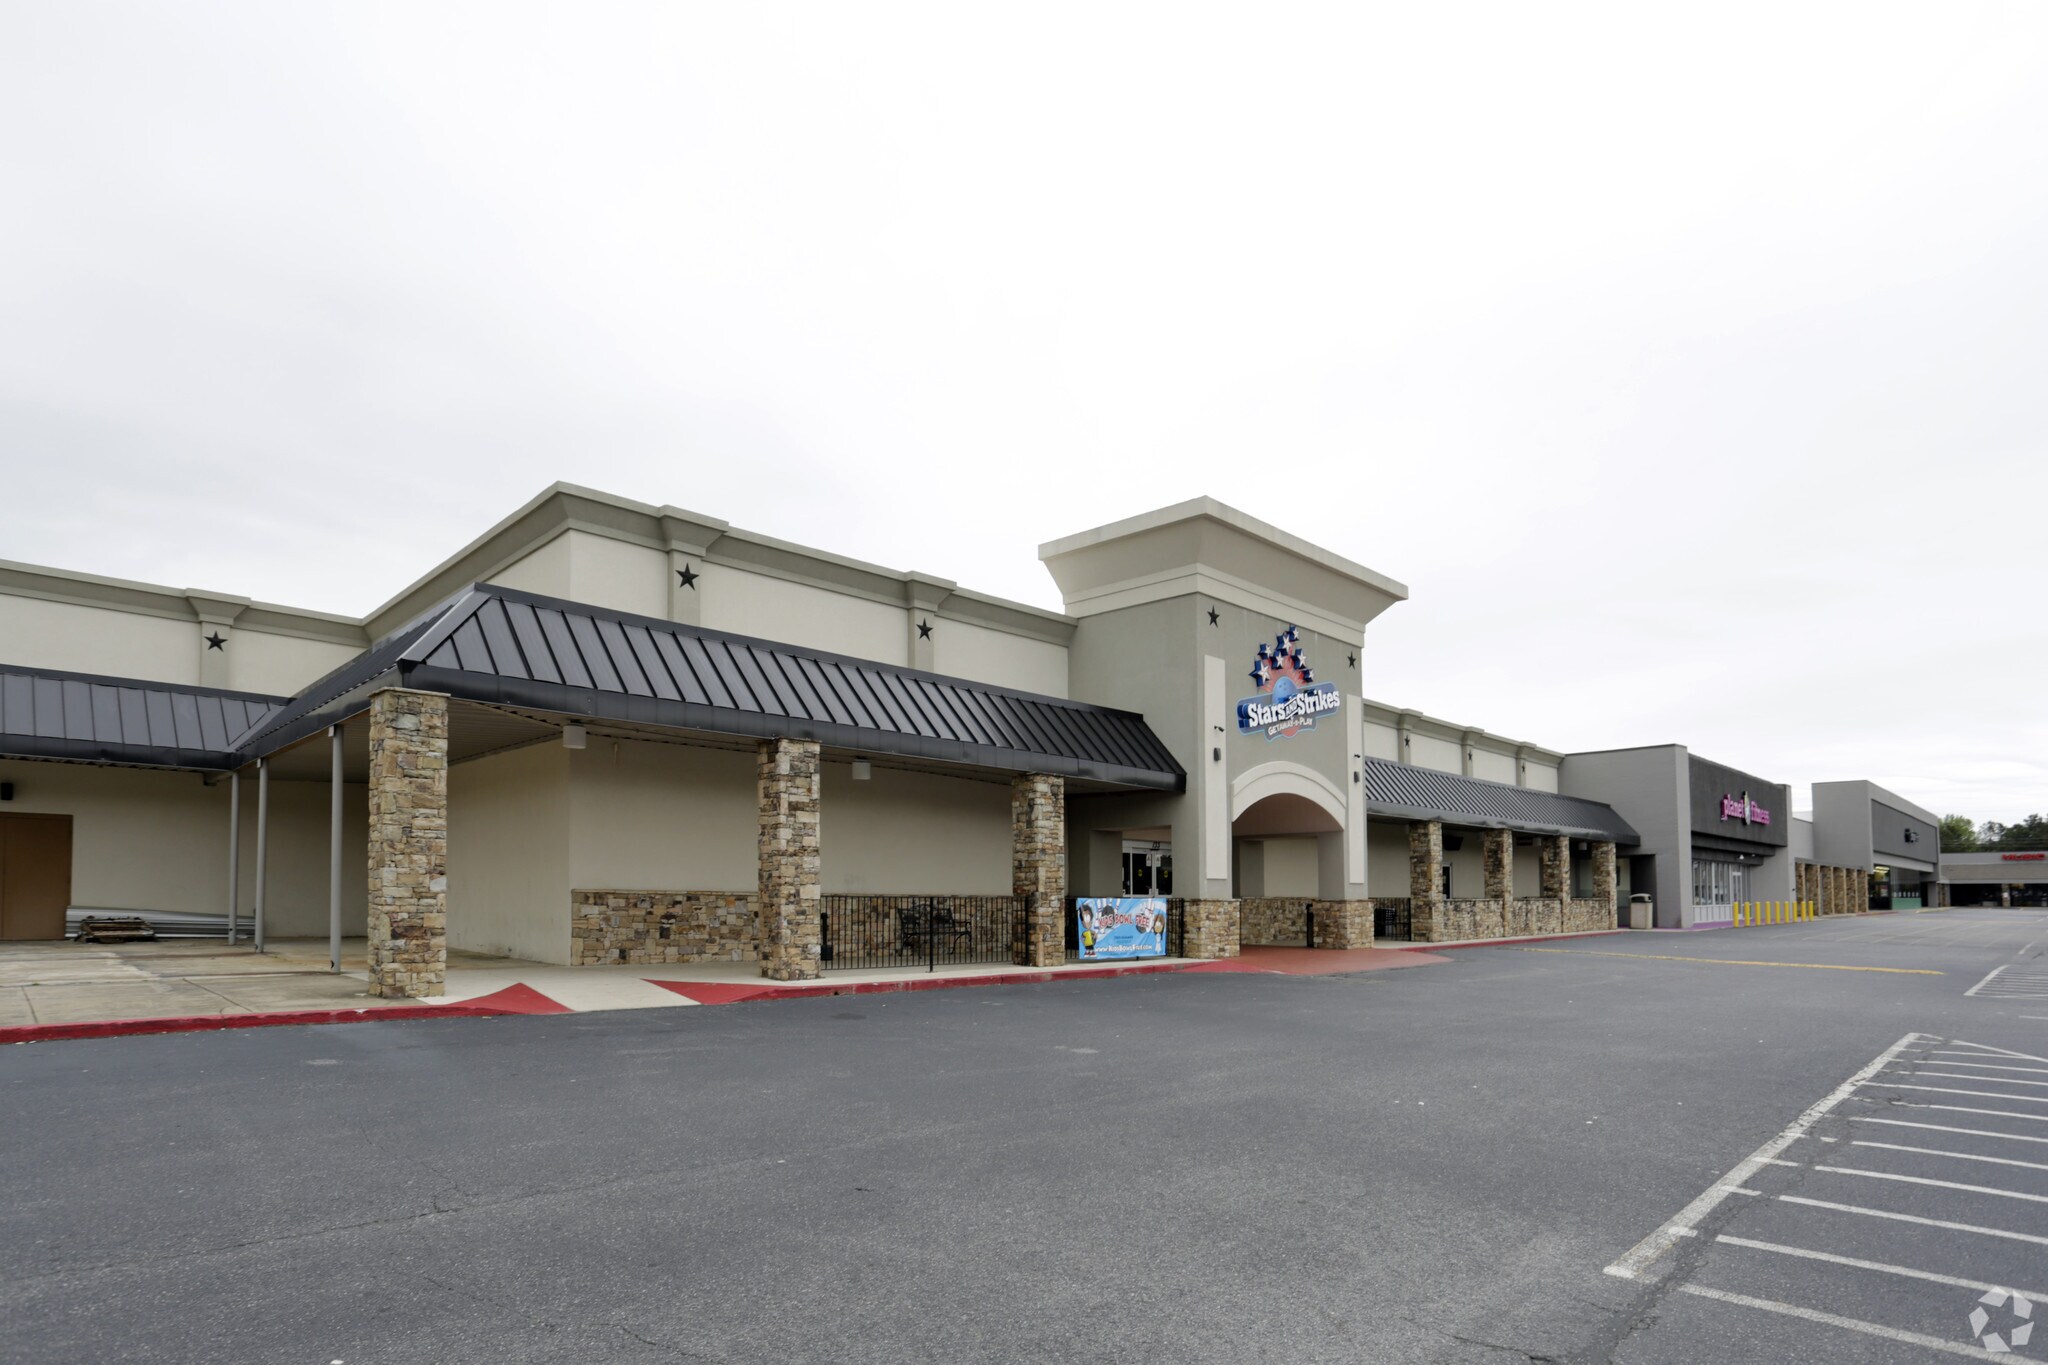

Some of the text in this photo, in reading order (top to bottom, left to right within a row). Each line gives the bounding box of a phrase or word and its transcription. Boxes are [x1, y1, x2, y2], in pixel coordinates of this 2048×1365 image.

[1247, 690, 1340, 728] Stars AND Strikes
[1721, 794, 1770, 824] planet fitness
[1099, 913, 1150, 928] KIDS BOWL FREE
